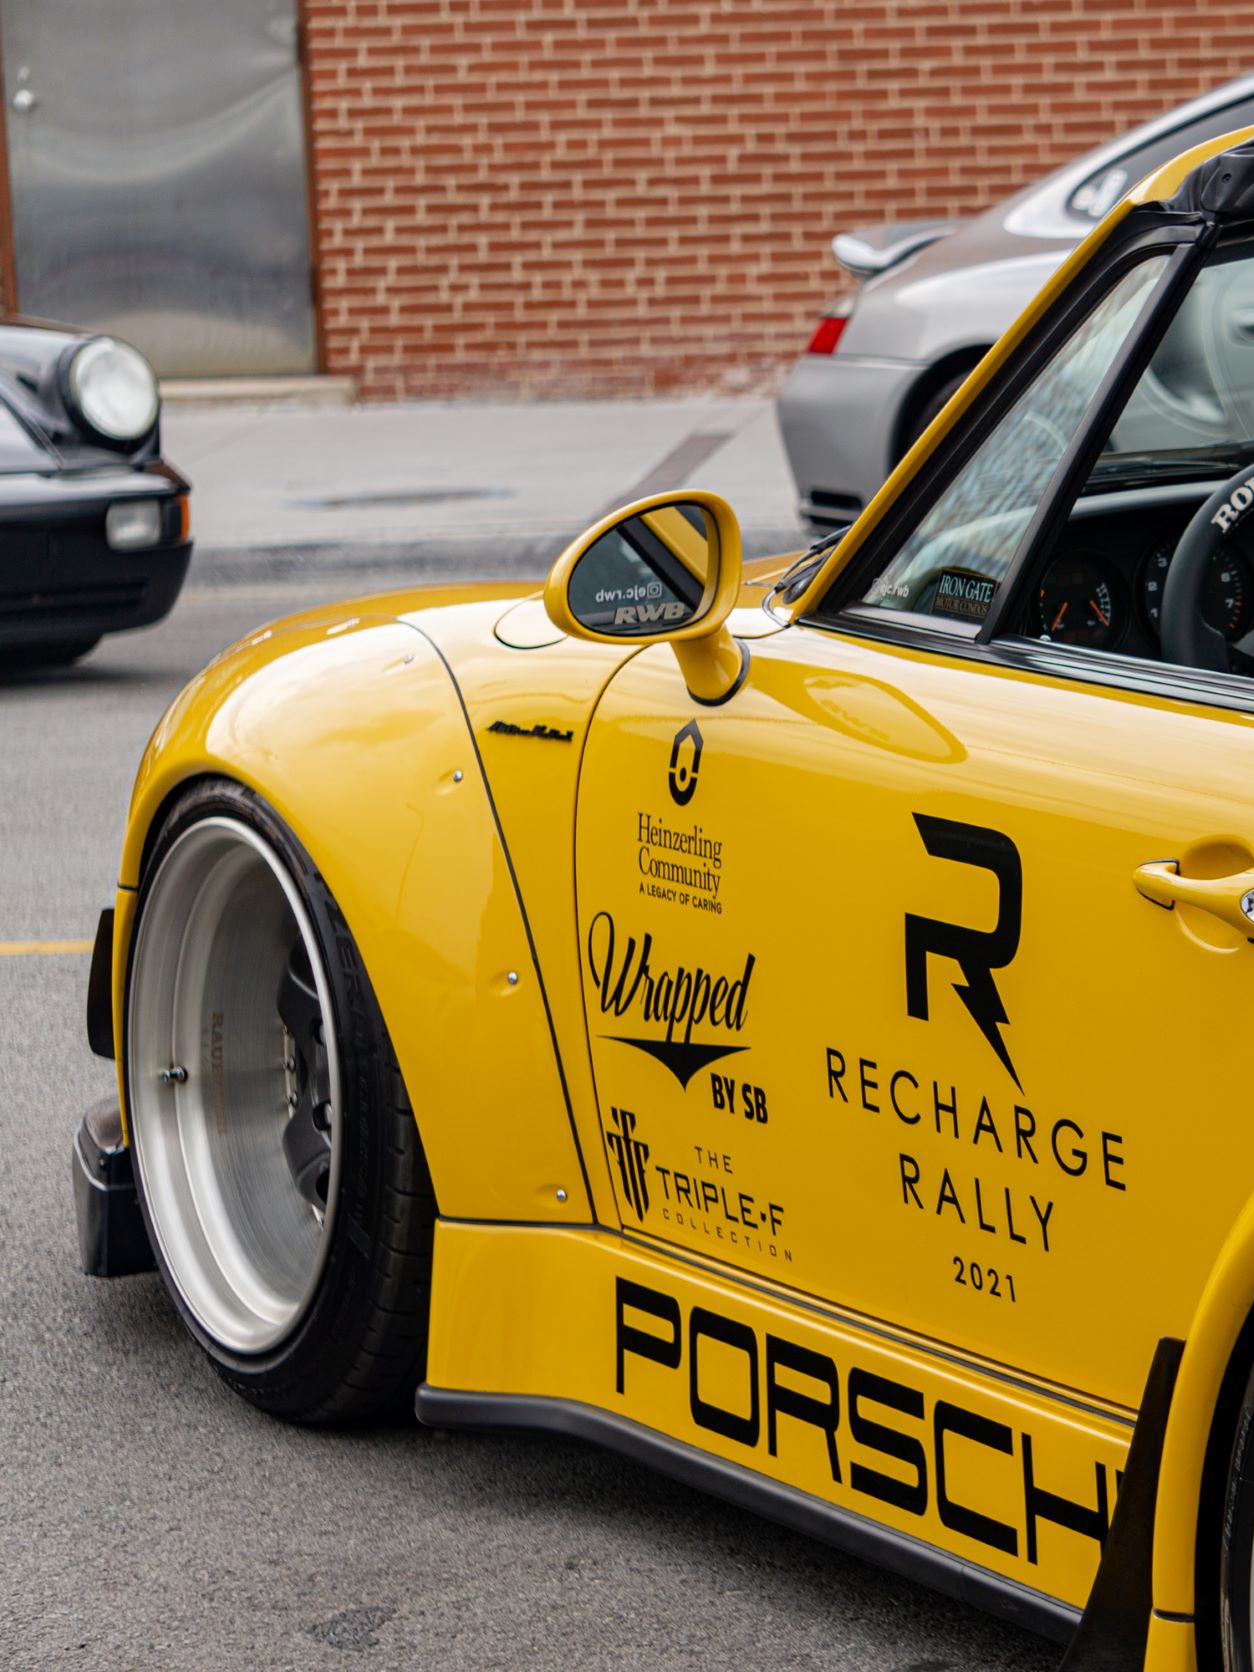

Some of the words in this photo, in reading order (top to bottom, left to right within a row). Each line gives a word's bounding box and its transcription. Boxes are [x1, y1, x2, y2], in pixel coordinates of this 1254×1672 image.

[939, 574, 967, 598] IRON
[965, 579, 994, 603] GATE
[1147, 581, 1158, 592] 2
[614, 602, 686, 625] RWB
[637, 812, 723, 869] Heinzerling
[638, 846, 721, 900] Community
[639, 882, 645, 894] A
[647, 883, 677, 902] LEGACY
[679, 892, 690, 905] OF
[692, 895, 722, 915] CARING
[588, 911, 756, 1043] Wrapped
[710, 1072, 736, 1114] BY
[741, 1083, 768, 1124] SB
[826, 1047, 1126, 1191] RECHARGE
[695, 1146, 733, 1174] THE
[899, 1153, 1054, 1253] RALLY
[662, 1208, 793, 1263] COLLECTION
[953, 1255, 1016, 1303] 2021
[615, 1276, 1124, 1566] PORSCH
